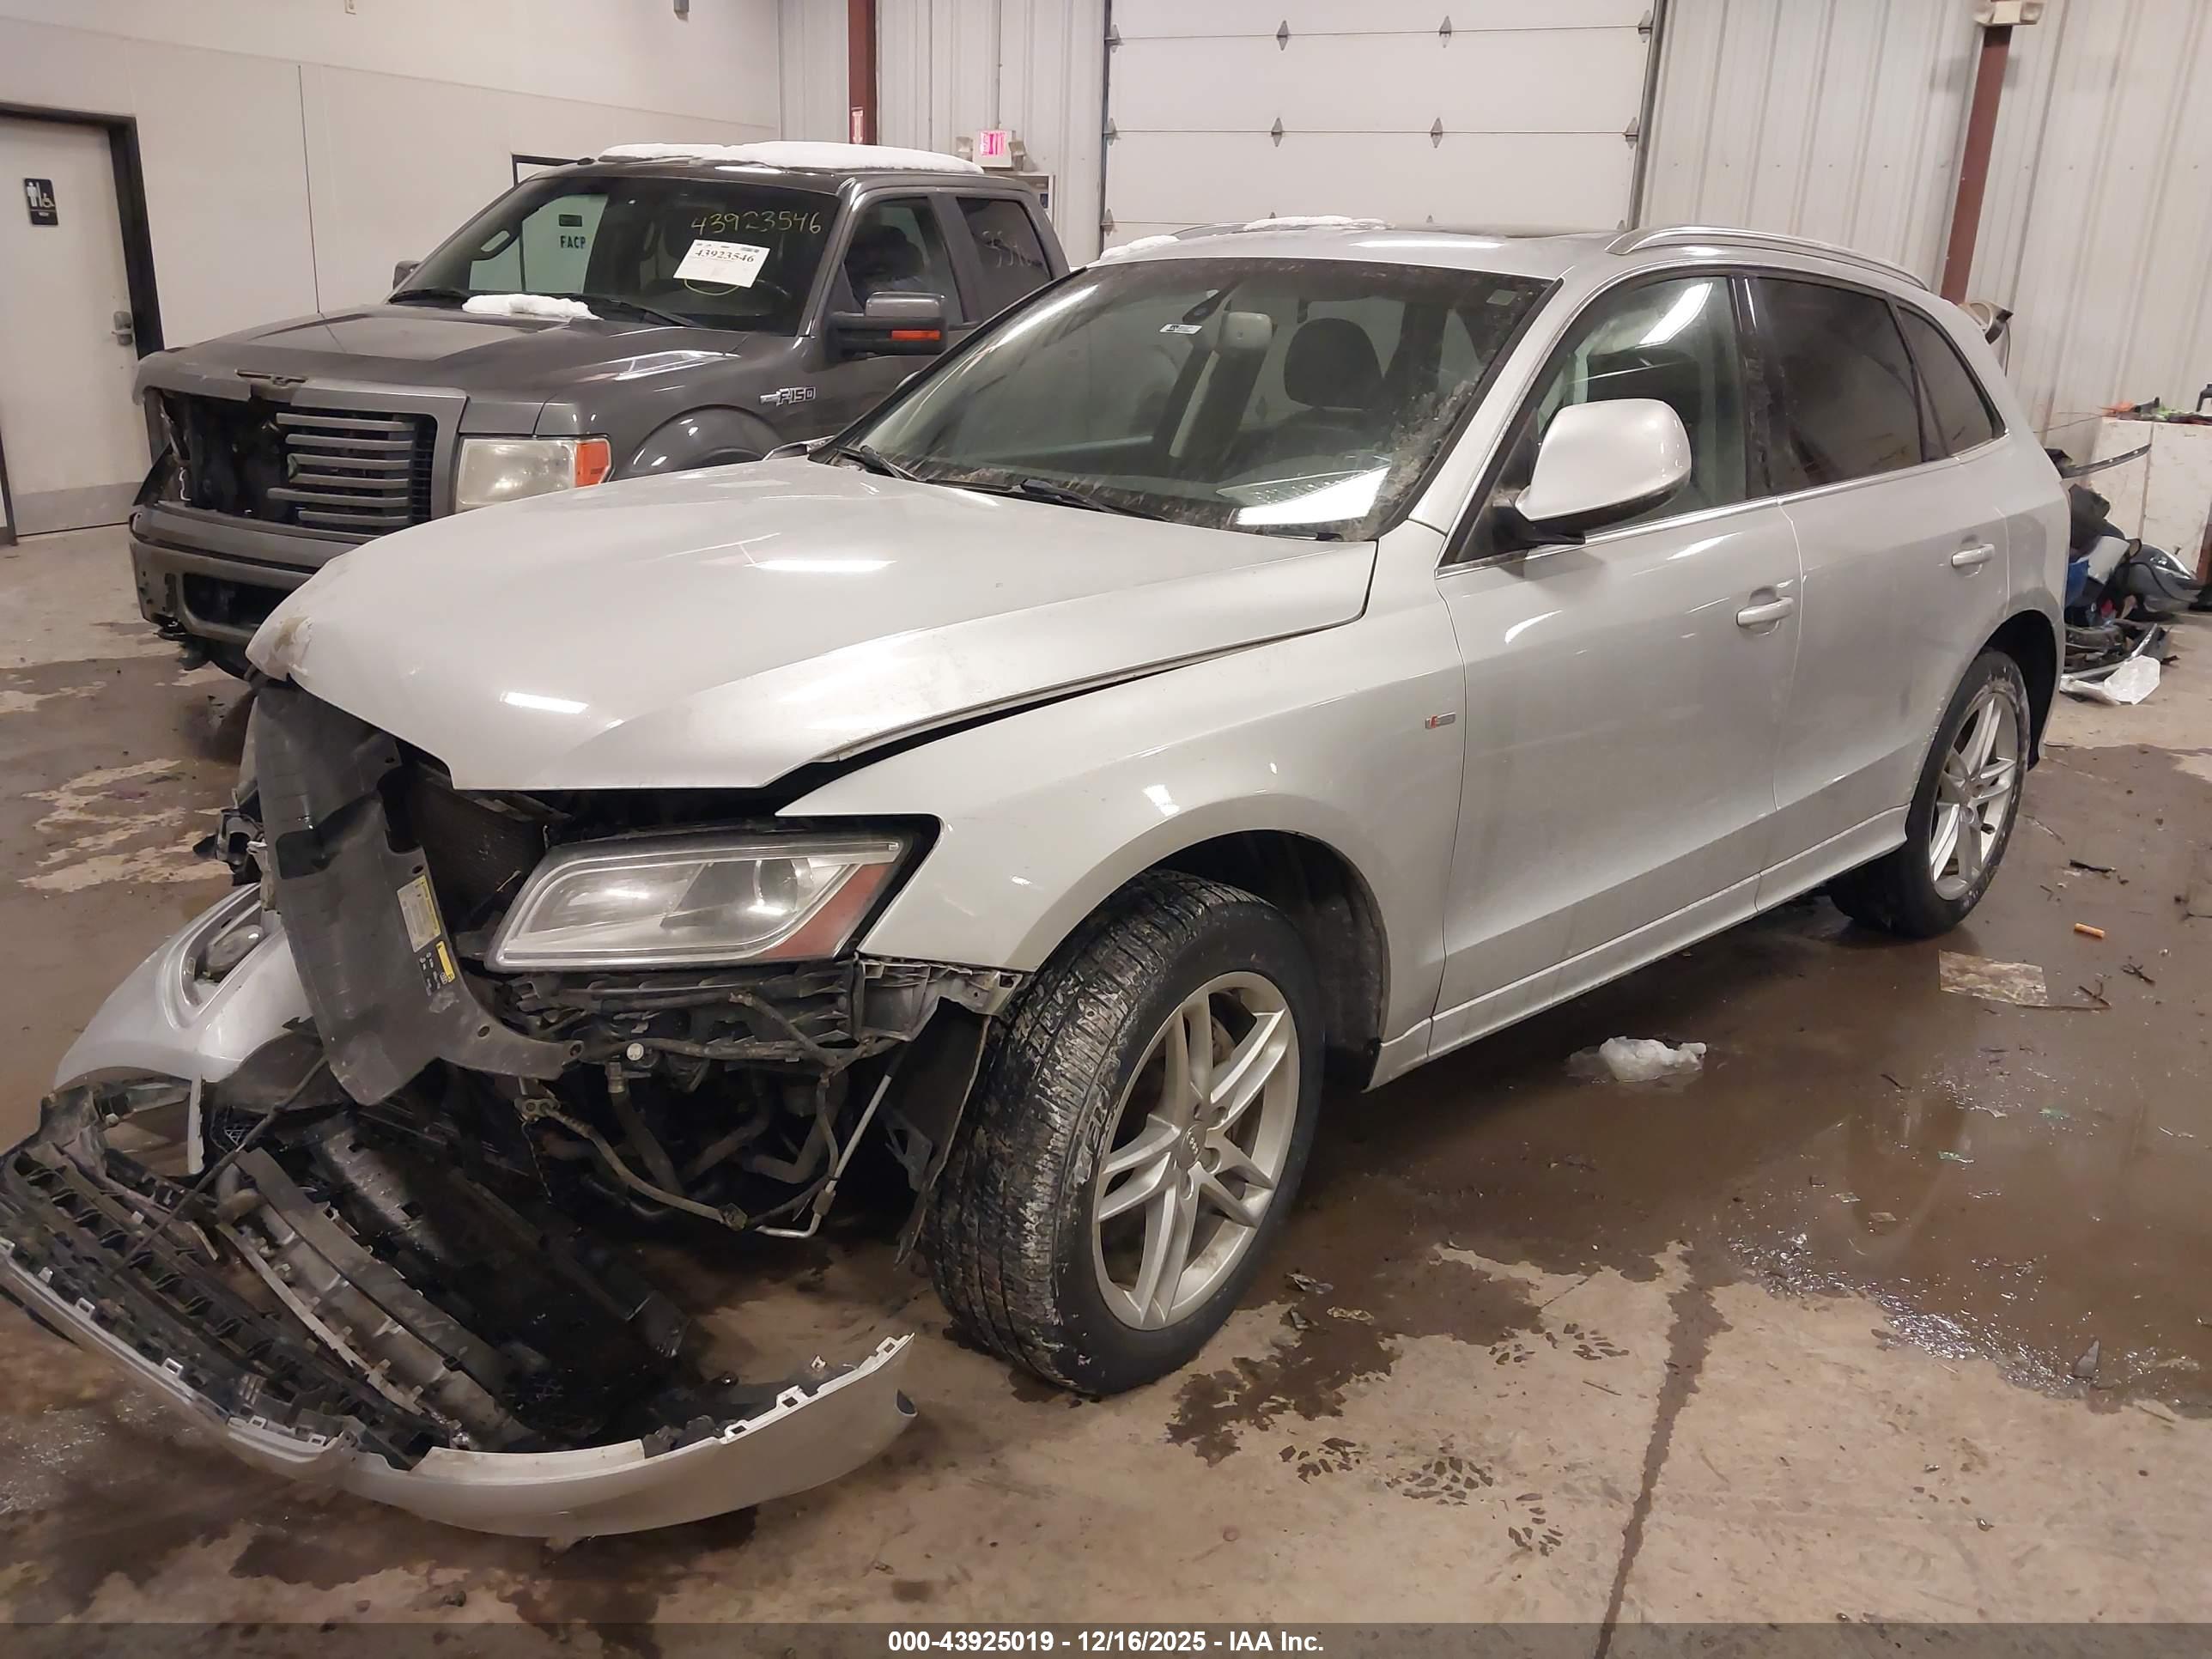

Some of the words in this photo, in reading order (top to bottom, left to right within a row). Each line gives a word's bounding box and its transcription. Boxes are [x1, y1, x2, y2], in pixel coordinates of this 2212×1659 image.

[690, 211, 821, 235] 43923546
[560, 235, 586, 248] FACP
[695, 248, 755, 263] 43923546
